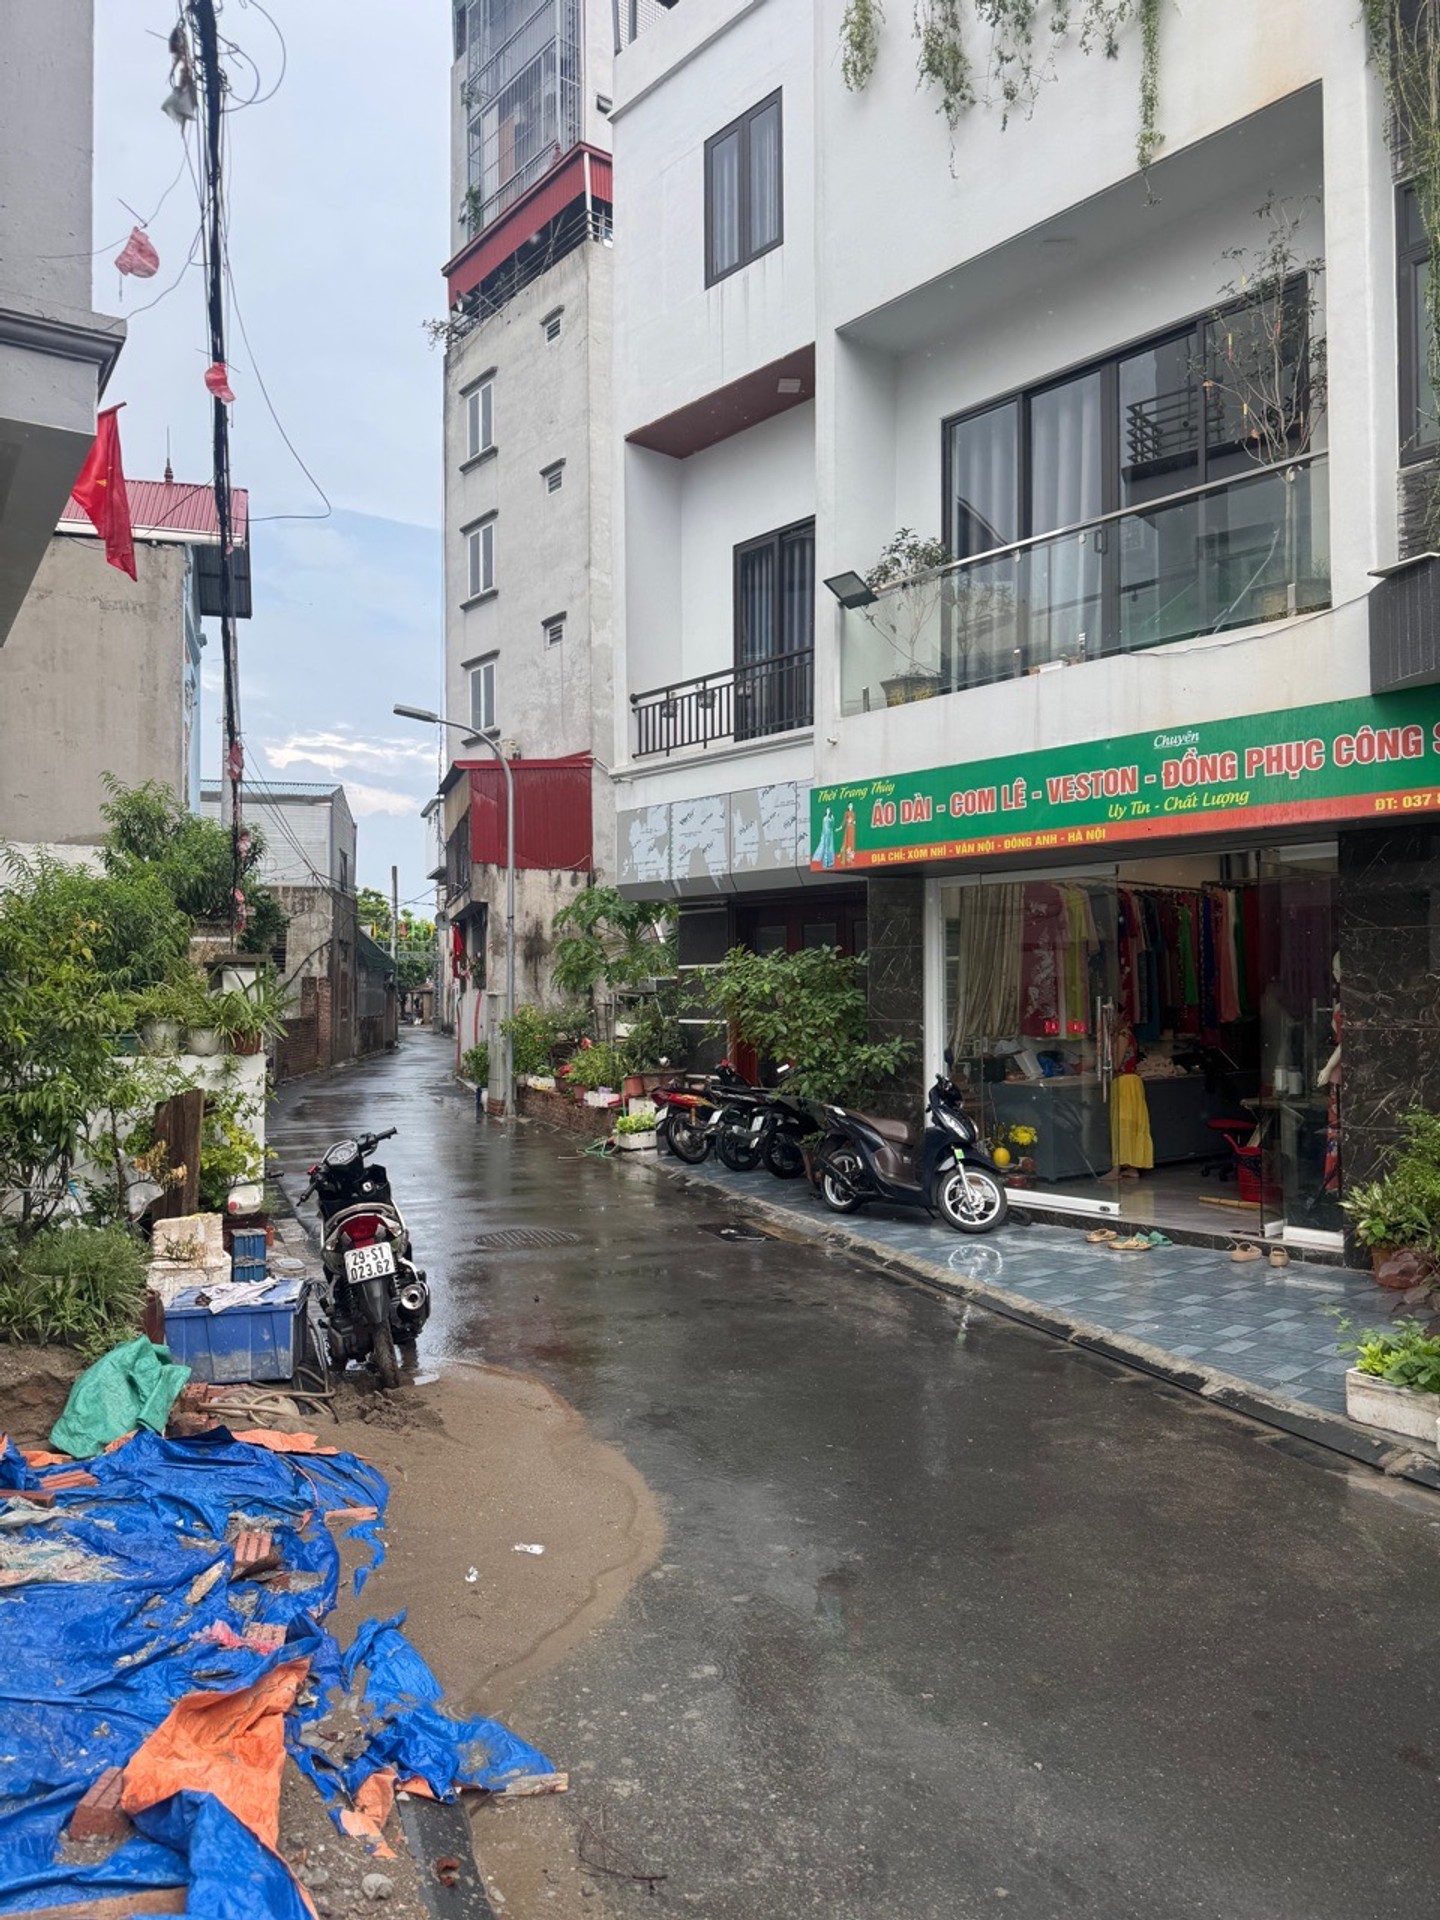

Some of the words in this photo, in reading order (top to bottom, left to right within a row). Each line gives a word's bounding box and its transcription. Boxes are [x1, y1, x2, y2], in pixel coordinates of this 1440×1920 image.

[1153, 730, 1200, 748] Chuyên
[871, 798, 896, 828] ÁO
[900, 792, 932, 824] DÀI
[936, 804, 946, 812] -
[950, 786, 998, 818] COM
[1001, 777, 1027, 811] LÊ
[1031, 790, 1042, 800] -
[1046, 764, 1139, 805] VESTON
[1144, 774, 1157, 784] -
[1161, 747, 1239, 790] ĐỒNG
[1245, 738, 1326, 779] PHỤC
[1333, 724, 1424, 767] CÔNG
[839, 786, 869, 801] Trang
[1402, 793, 1432, 808] 037
[1108, 803, 1127, 820] Uy
[1164, 792, 1198, 811] Chất
[1202, 791, 1250, 807] Lượng
[1034, 833, 1057, 846] ANH
[1068, 828, 1083, 843] HÀ
[1086, 827, 1106, 842] NỘI
[351, 1258, 390, 1281] 023.62
